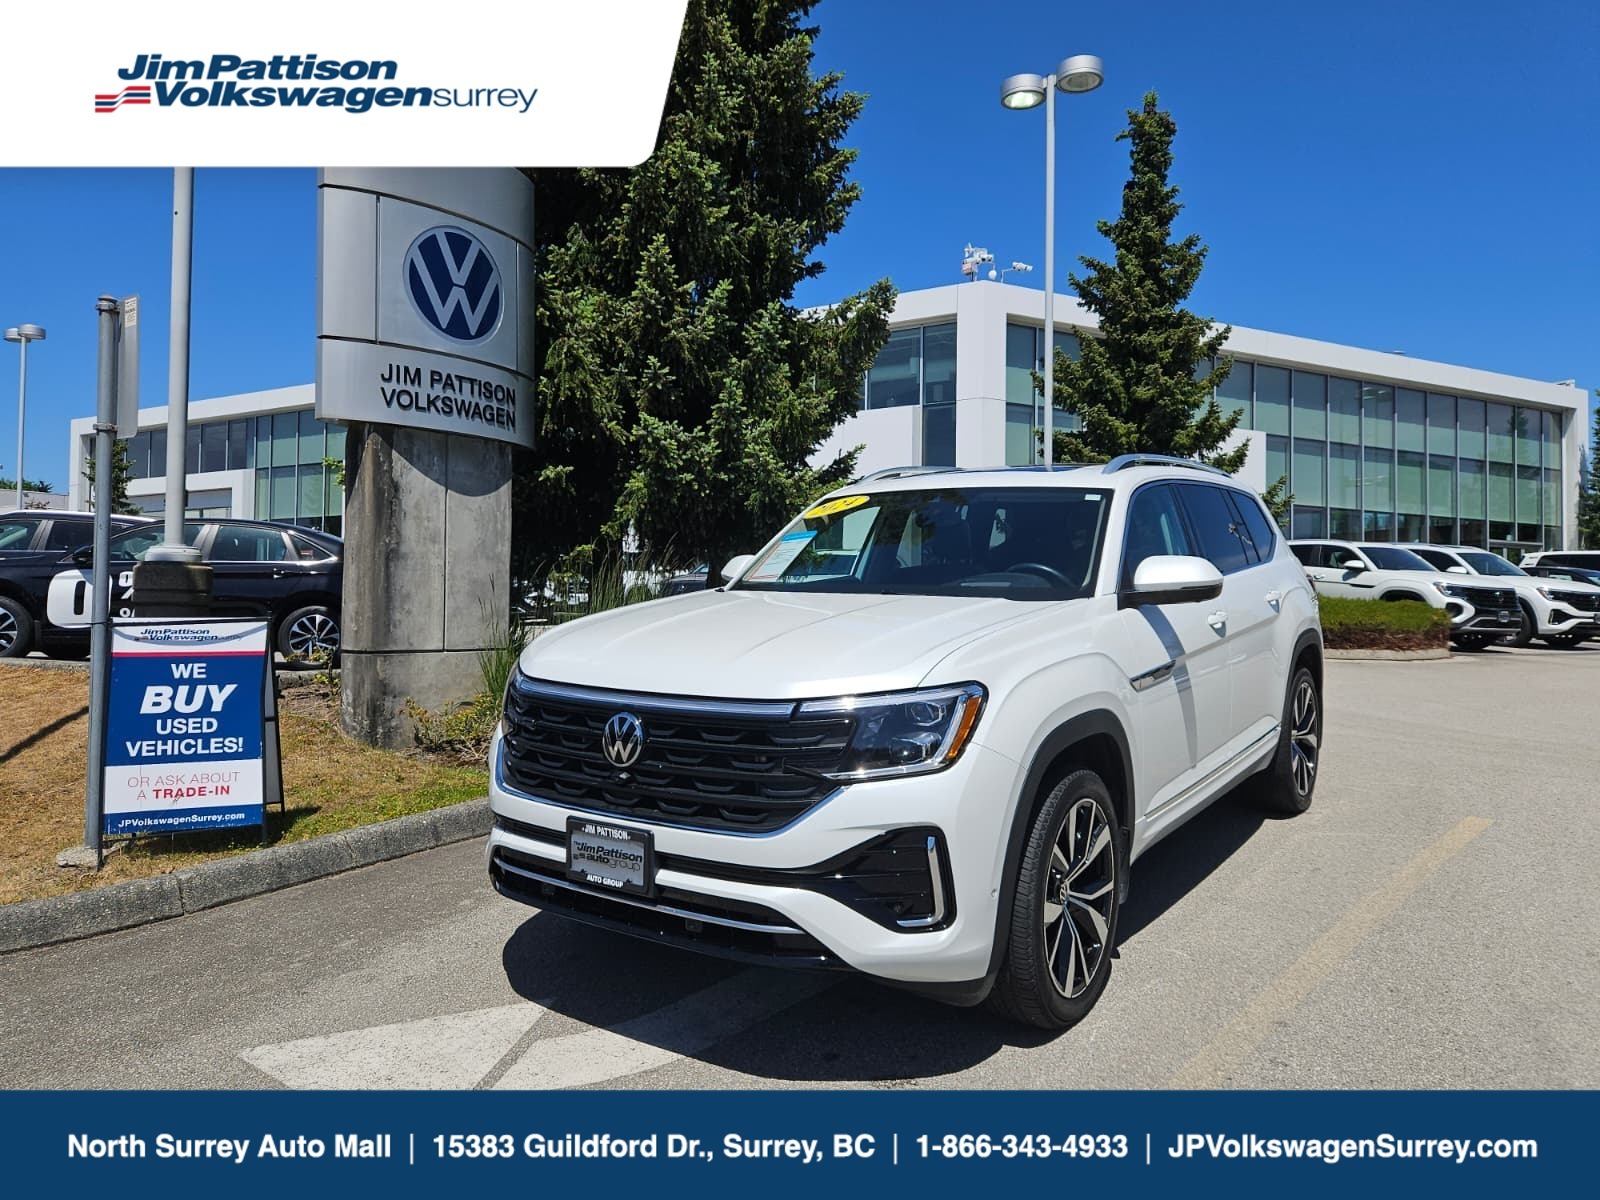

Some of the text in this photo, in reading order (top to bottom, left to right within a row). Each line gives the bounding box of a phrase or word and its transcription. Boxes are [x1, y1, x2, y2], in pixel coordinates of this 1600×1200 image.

[380, 363, 516, 406] JIM PATTISON
[380, 387, 516, 430] VOLKSWAGEN
[171, 663, 207, 679] WE
[139, 684, 238, 714] BUY
[156, 717, 218, 735] USED
[125, 737, 243, 757] VEHICLES!
[127, 771, 240, 788] OR ASK ABOUT
[136, 785, 230, 801] A TRADE-IN
[118, 812, 245, 828] JPVolkswagenSurrey.com
[584, 824, 628, 840] JIM PATTISON
[586, 874, 624, 888] AUTO GROUP
